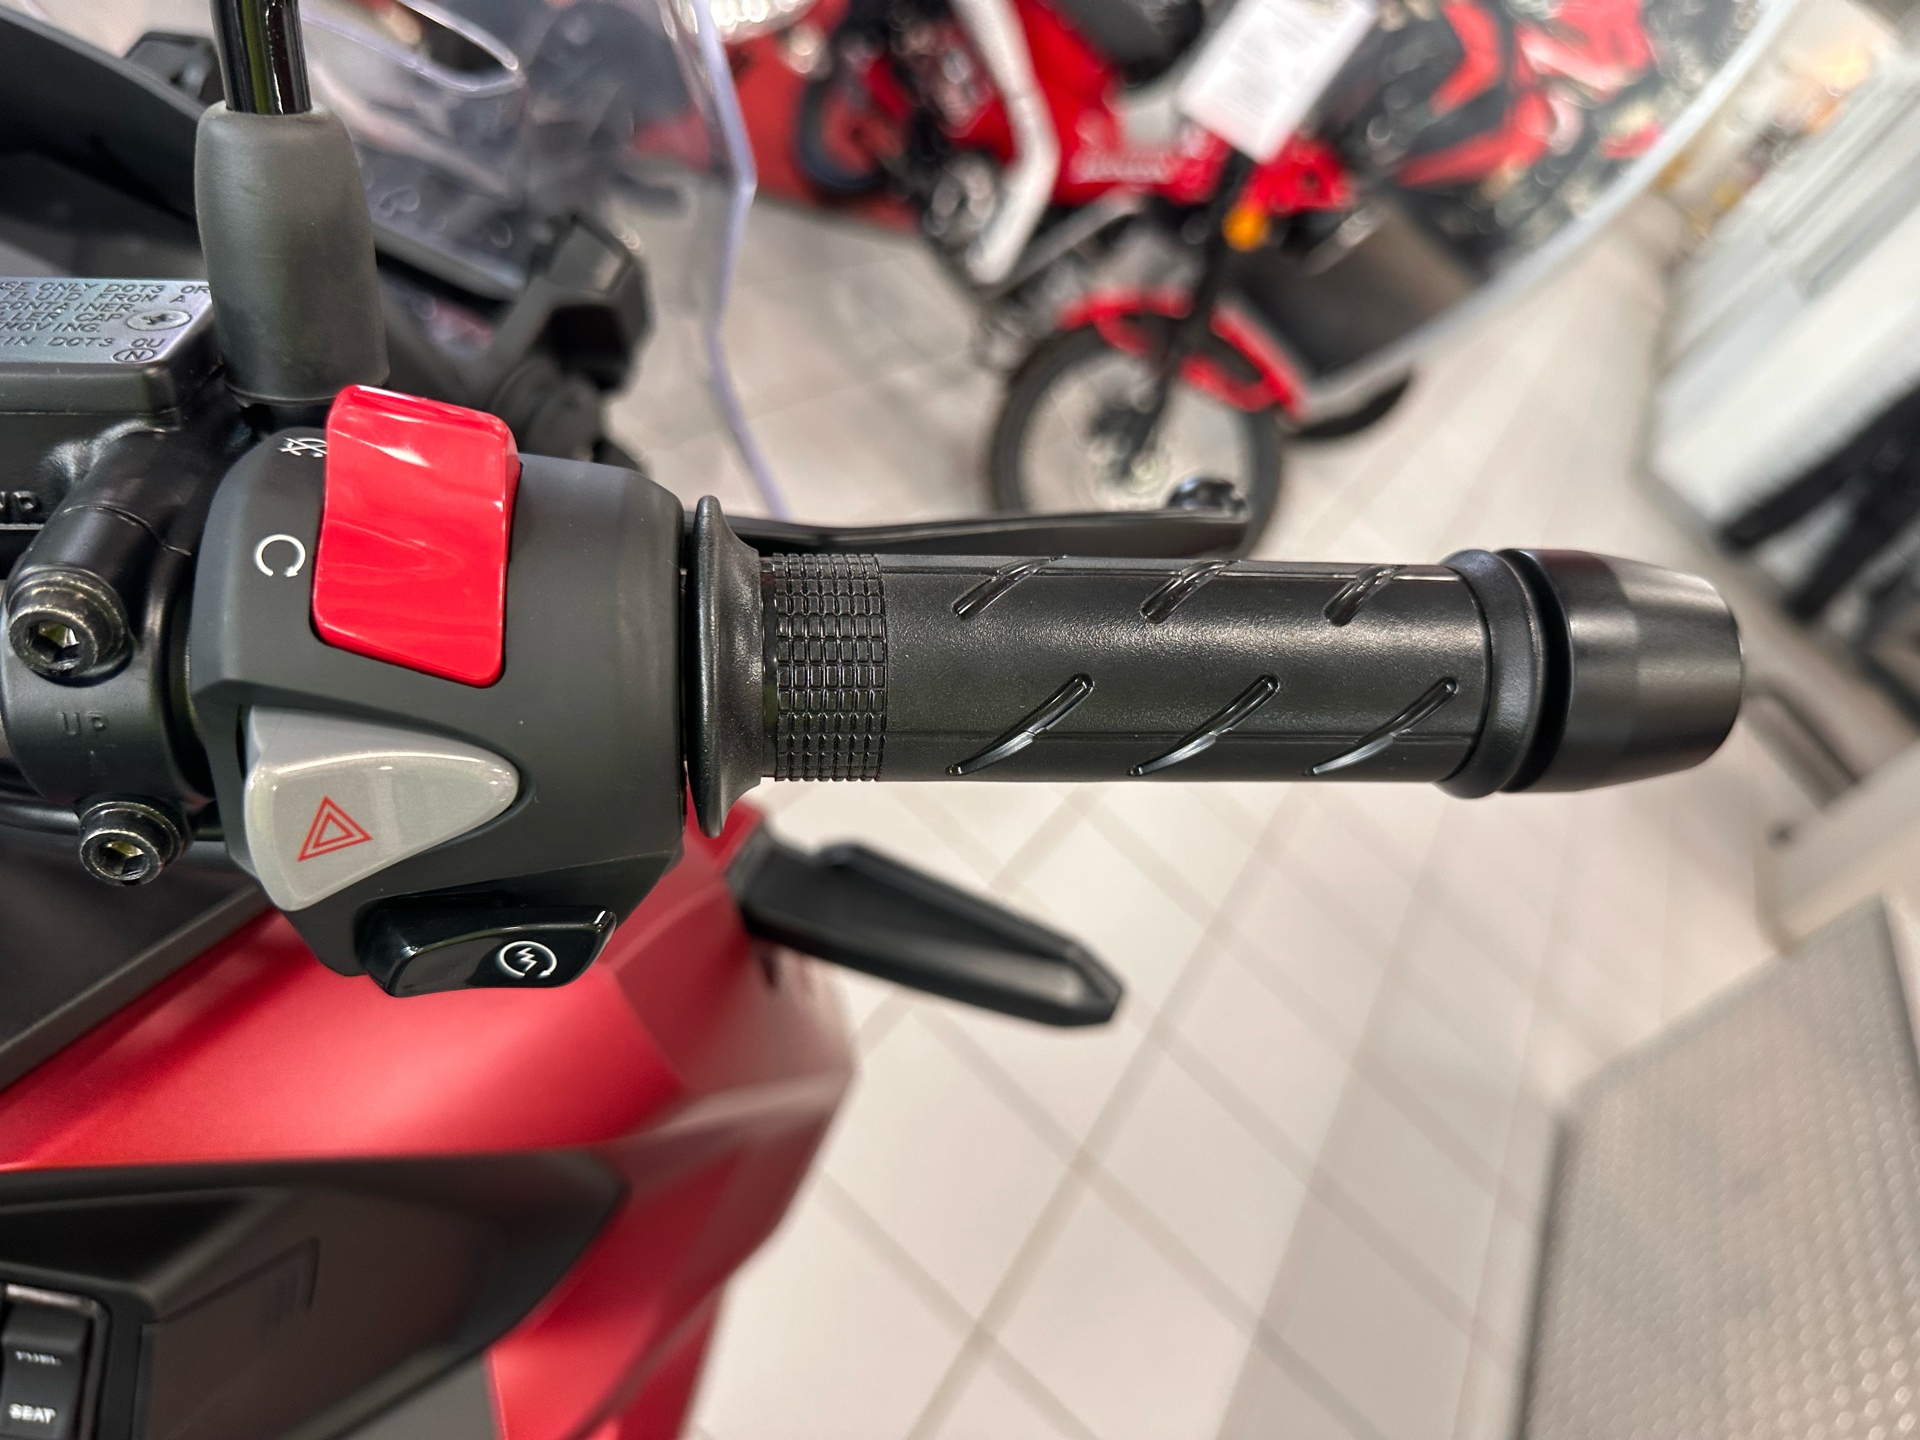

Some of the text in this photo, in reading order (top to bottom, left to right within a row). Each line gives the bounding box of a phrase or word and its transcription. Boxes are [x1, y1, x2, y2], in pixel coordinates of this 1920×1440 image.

[39, 282, 99, 293] ONLY
[3, 291, 83, 301] FLUID
[169, 294, 186, 303] A
[74, 312, 125, 322] CAP
[130, 337, 166, 348] OU
[60, 711, 109, 737] UP
[9, 1403, 57, 1424] SEAT
